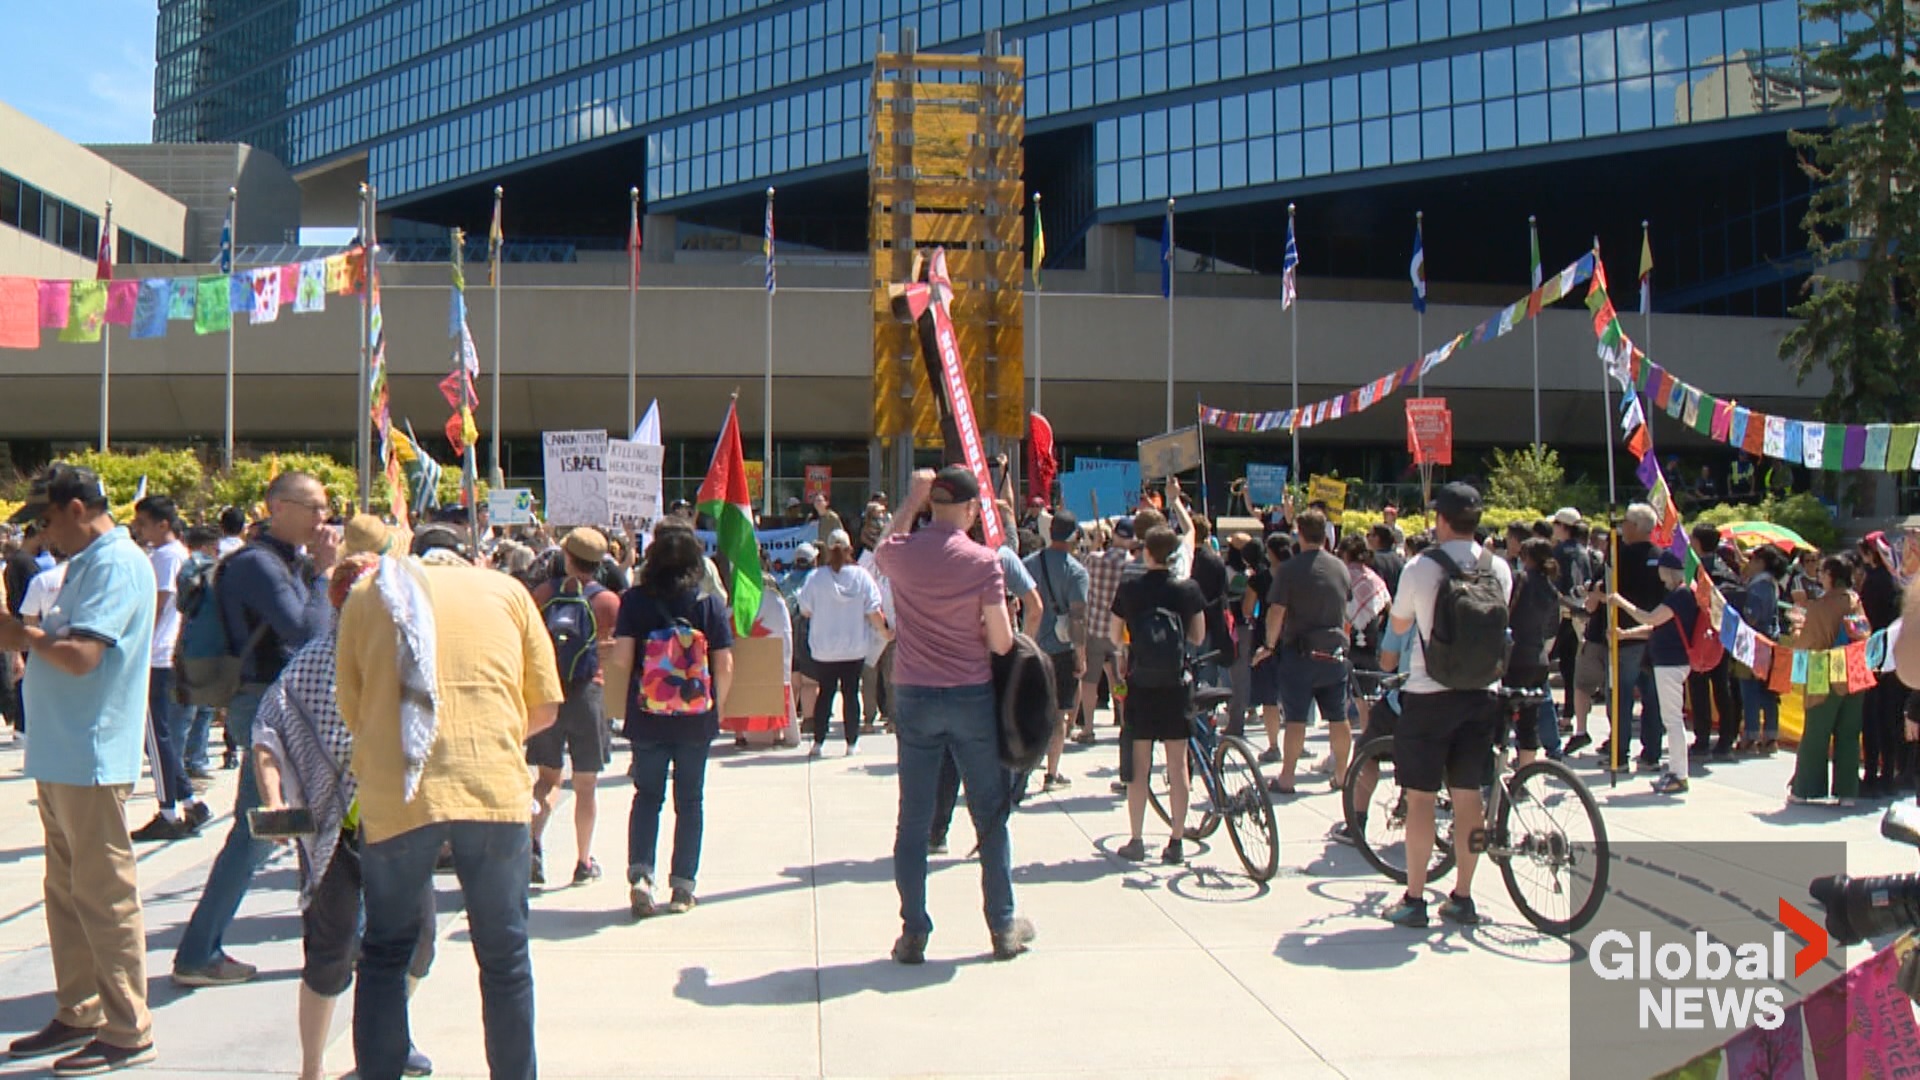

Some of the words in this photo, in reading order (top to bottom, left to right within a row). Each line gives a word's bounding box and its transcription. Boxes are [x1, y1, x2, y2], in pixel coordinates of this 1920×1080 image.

[941, 329, 983, 477] TRANSITION
[610, 445, 648, 460] KILLING
[561, 456, 606, 472] ISRAEL
[609, 461, 659, 476] HEALTHCARE
[608, 476, 645, 489] WORKERS
[1874, 988, 1910, 1078] JUSTICE
